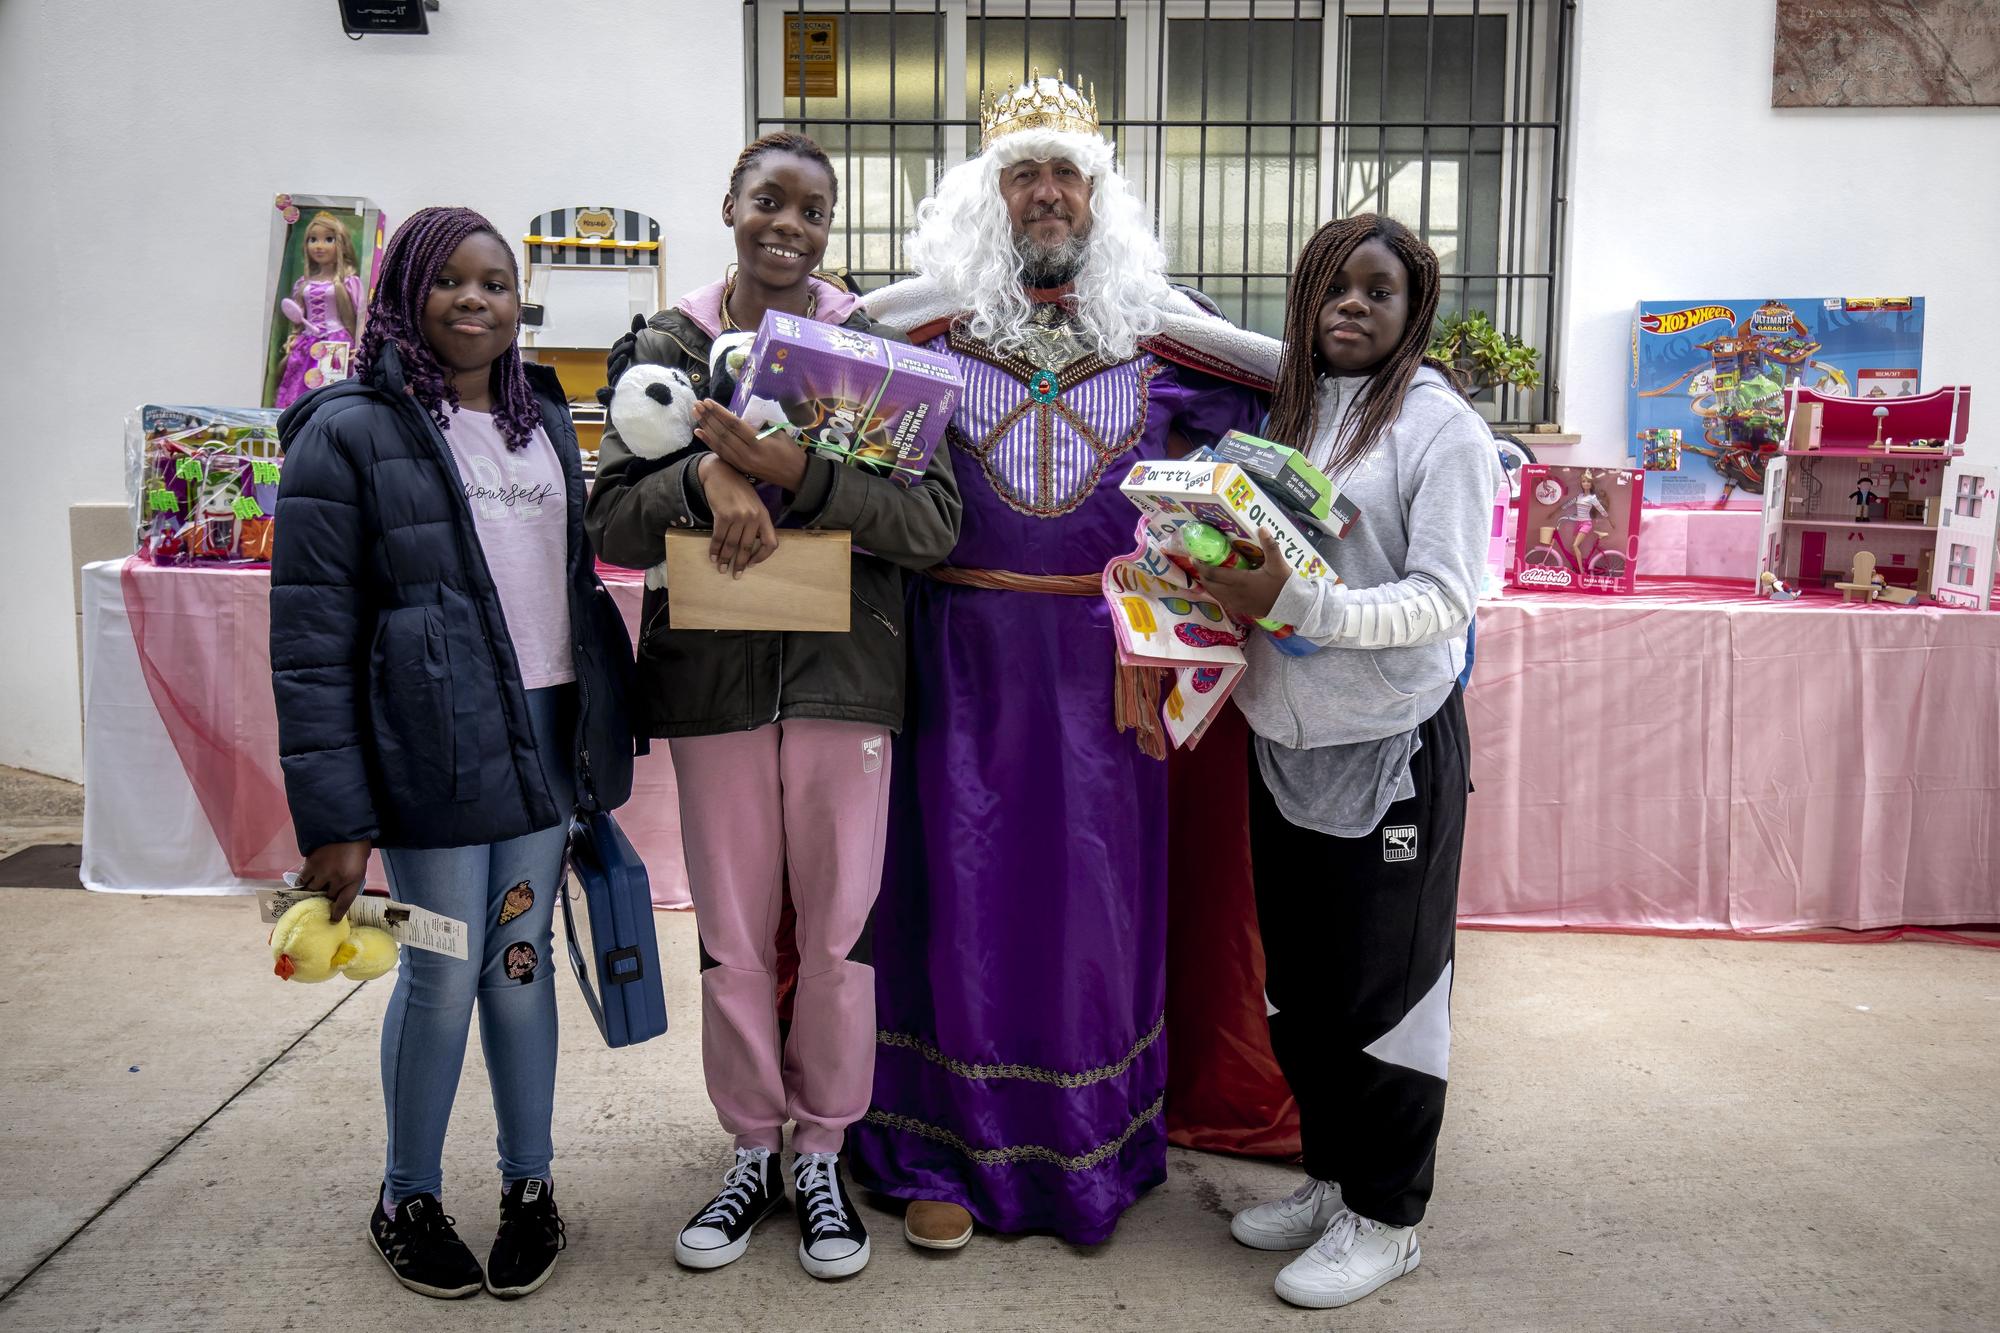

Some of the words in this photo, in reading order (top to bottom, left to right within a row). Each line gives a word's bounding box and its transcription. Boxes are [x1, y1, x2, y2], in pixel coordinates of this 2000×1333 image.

[1657, 314, 1687, 333] HOT
[1753, 311, 1793, 325] ULTIMATE
[891, 410, 915, 448] PREGUNTAS!
[908, 418, 922, 433] MÁS
[897, 442, 912, 459] 2500
[176, 457, 204, 482] HA
[250, 460, 280, 485] HA
[1185, 473, 1211, 490] Diset
[149, 488, 179, 513] HA
[231, 496, 264, 519] HA
[1130, 495, 1155, 513] Diset
[864, 738, 882, 751] PUMA
[1385, 828, 1415, 839] PUMA
